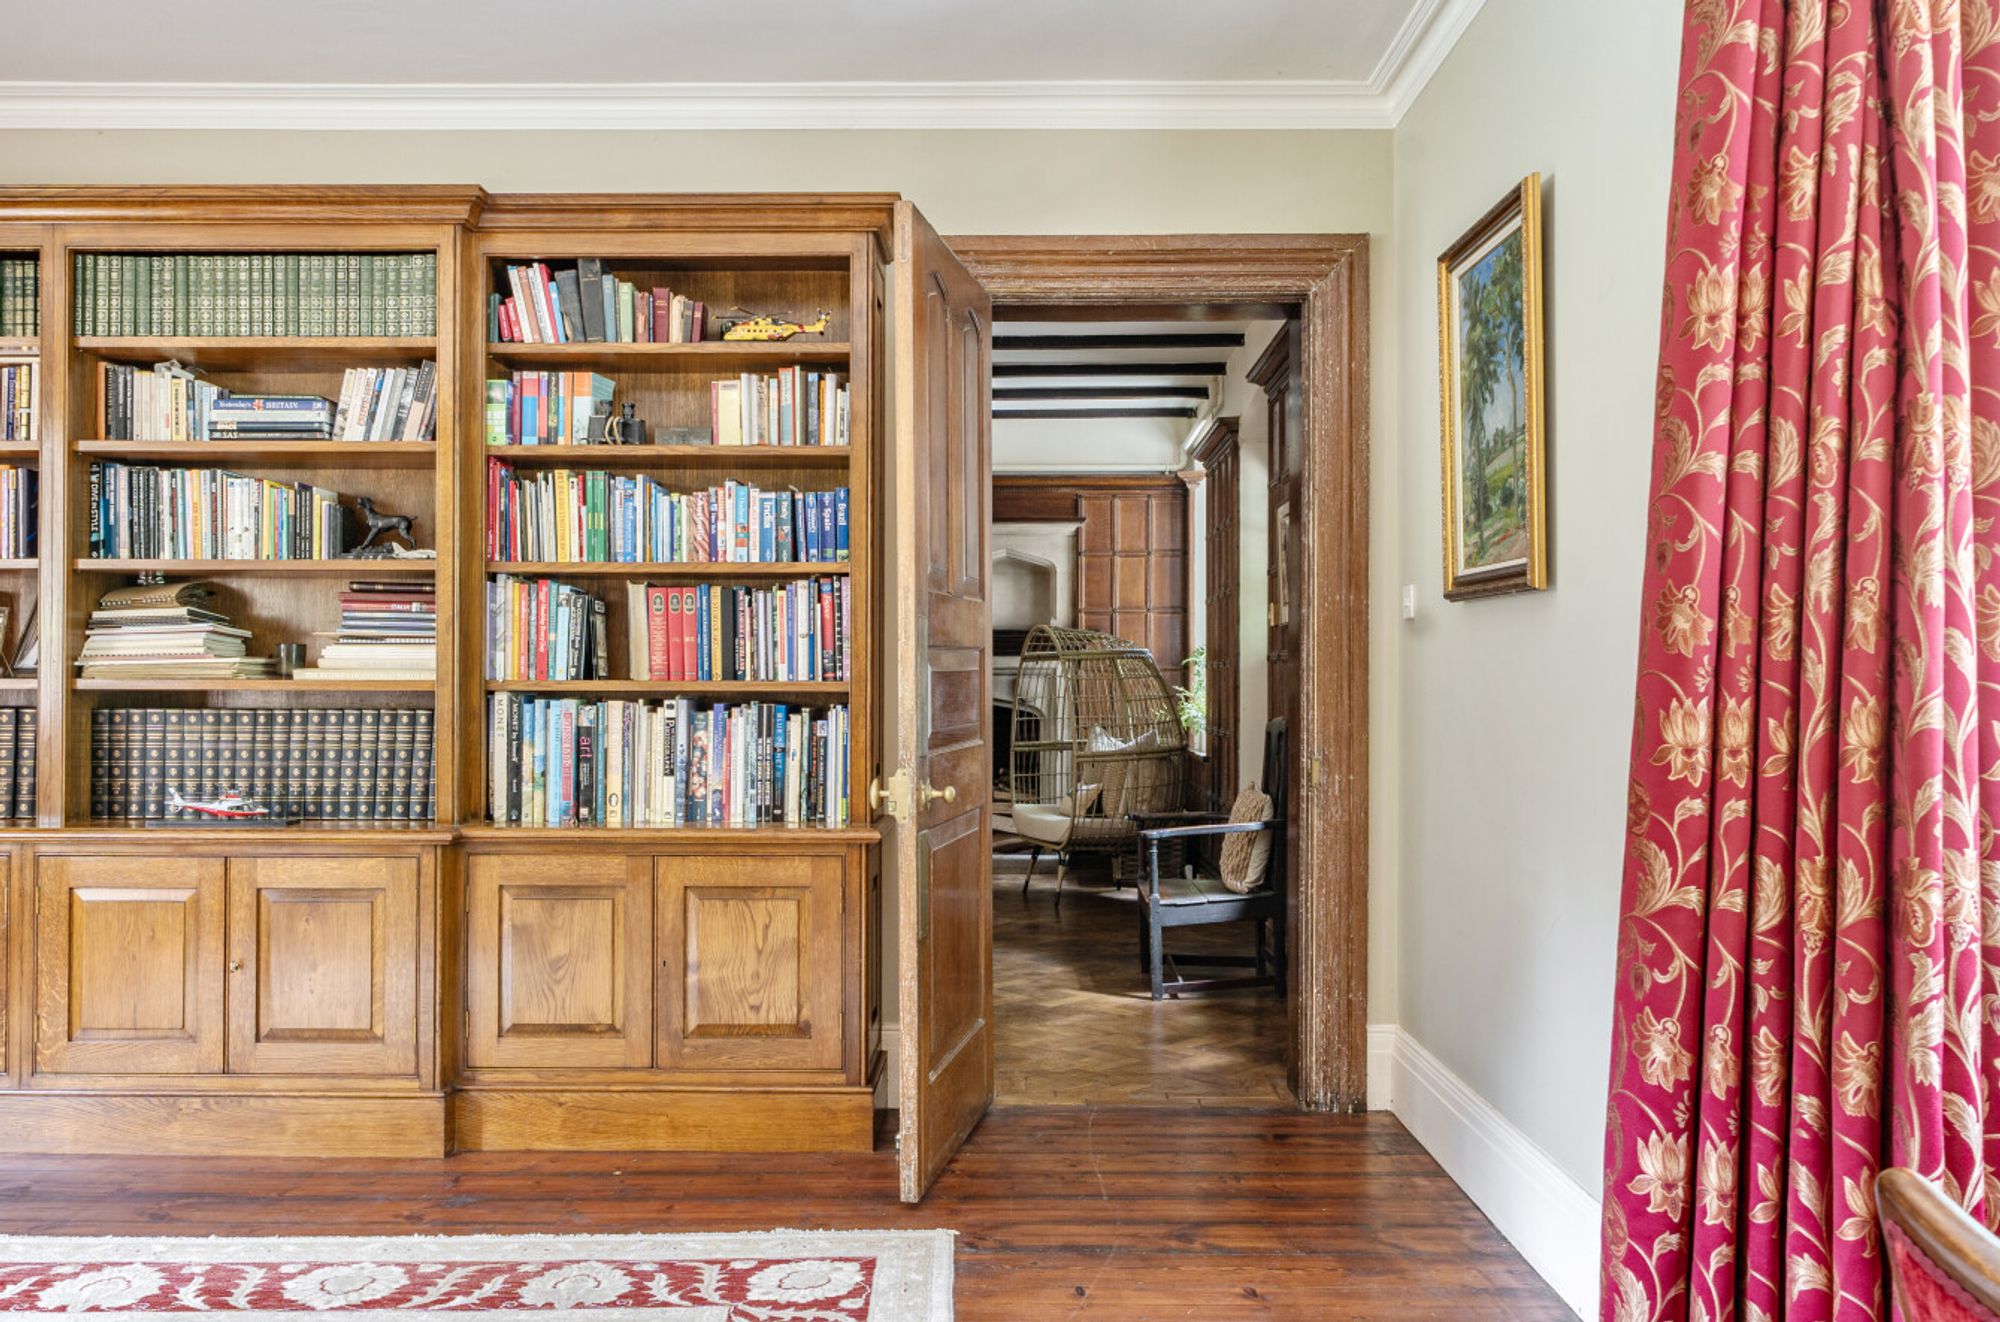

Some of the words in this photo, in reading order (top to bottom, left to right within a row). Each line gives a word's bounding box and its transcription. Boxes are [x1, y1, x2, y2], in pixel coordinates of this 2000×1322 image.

[91, 484, 99, 502] DIVE
[91, 510, 99, 532] STYLE
[763, 502, 774, 529] India
[780, 501, 789, 519] Italy
[822, 508, 832, 532] Spain
[837, 503, 847, 526] Brazil
[495, 699, 505, 738] MONET
[512, 703, 520, 731] MONET
[511, 731, 519, 739] by
[579, 736, 594, 758] art
